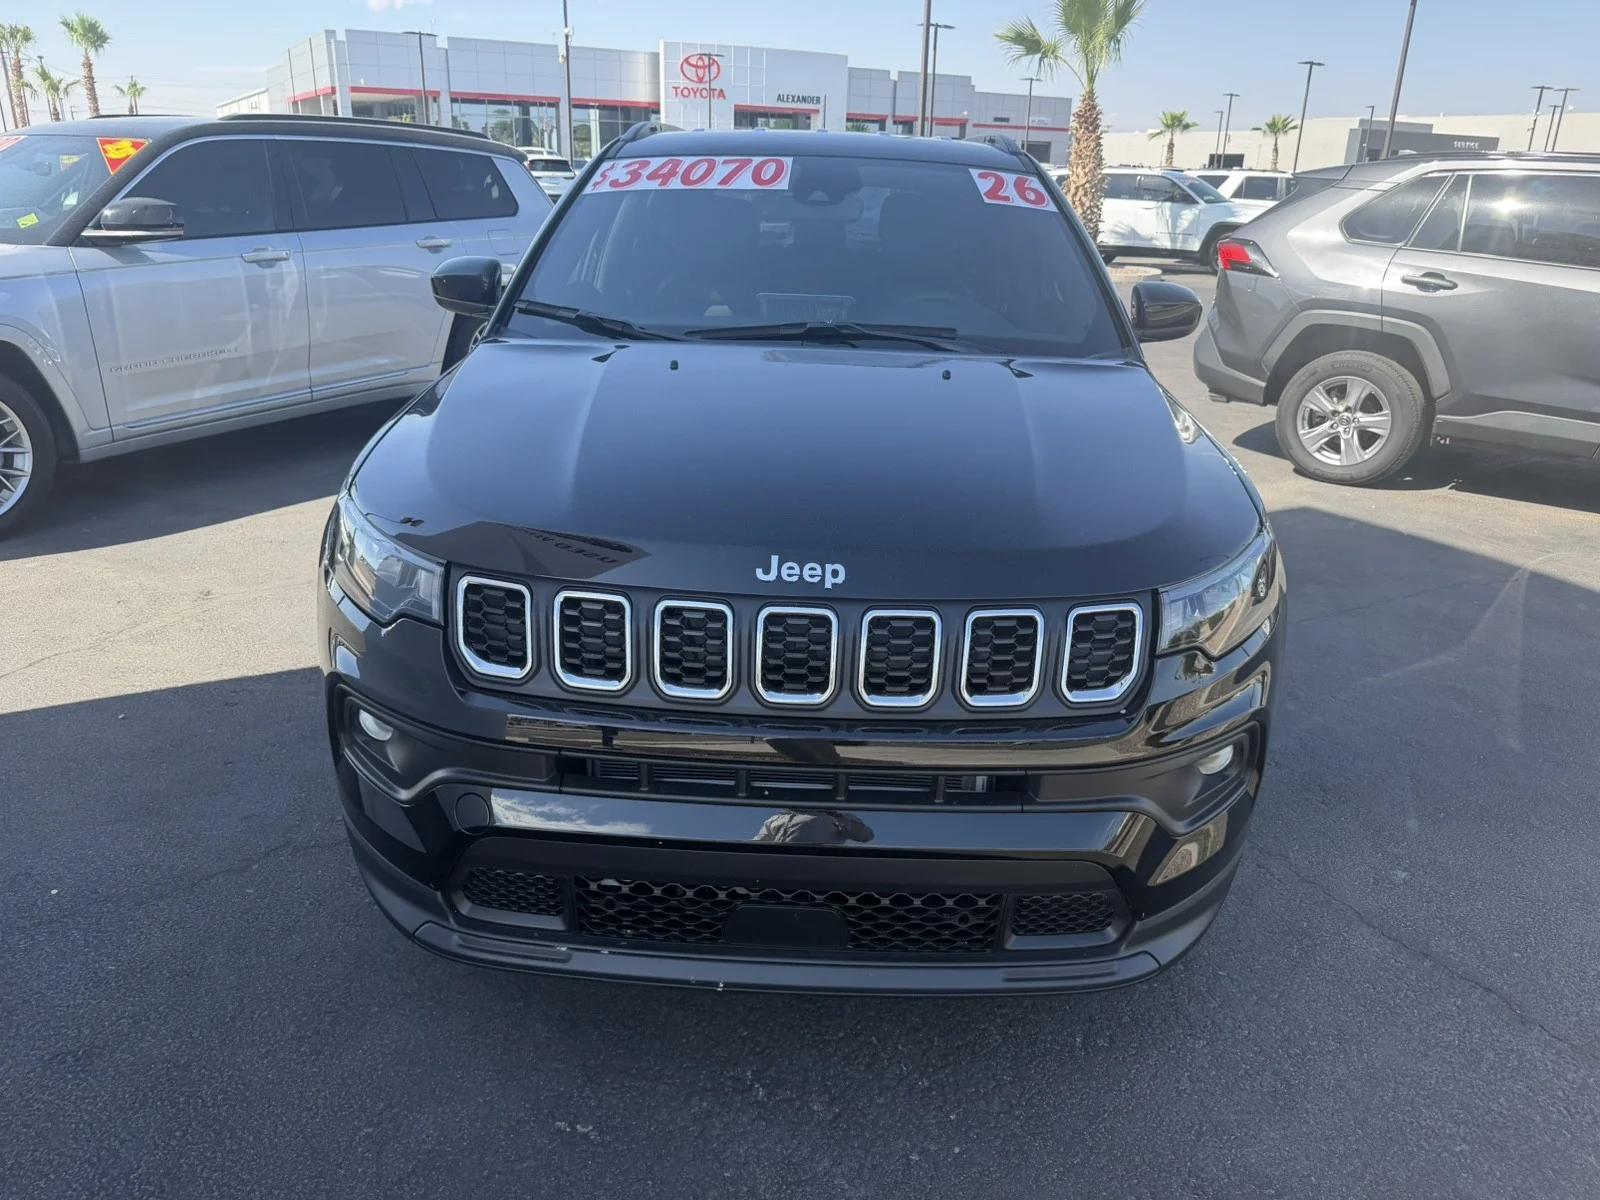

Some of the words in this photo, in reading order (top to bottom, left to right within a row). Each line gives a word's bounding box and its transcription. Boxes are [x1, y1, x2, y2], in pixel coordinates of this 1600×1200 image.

[672, 86, 726, 100] TOYOTA
[776, 93, 821, 105] ALEXANDER
[591, 157, 787, 191] $34070
[977, 171, 1049, 207] 26
[755, 554, 846, 589] Jeep
